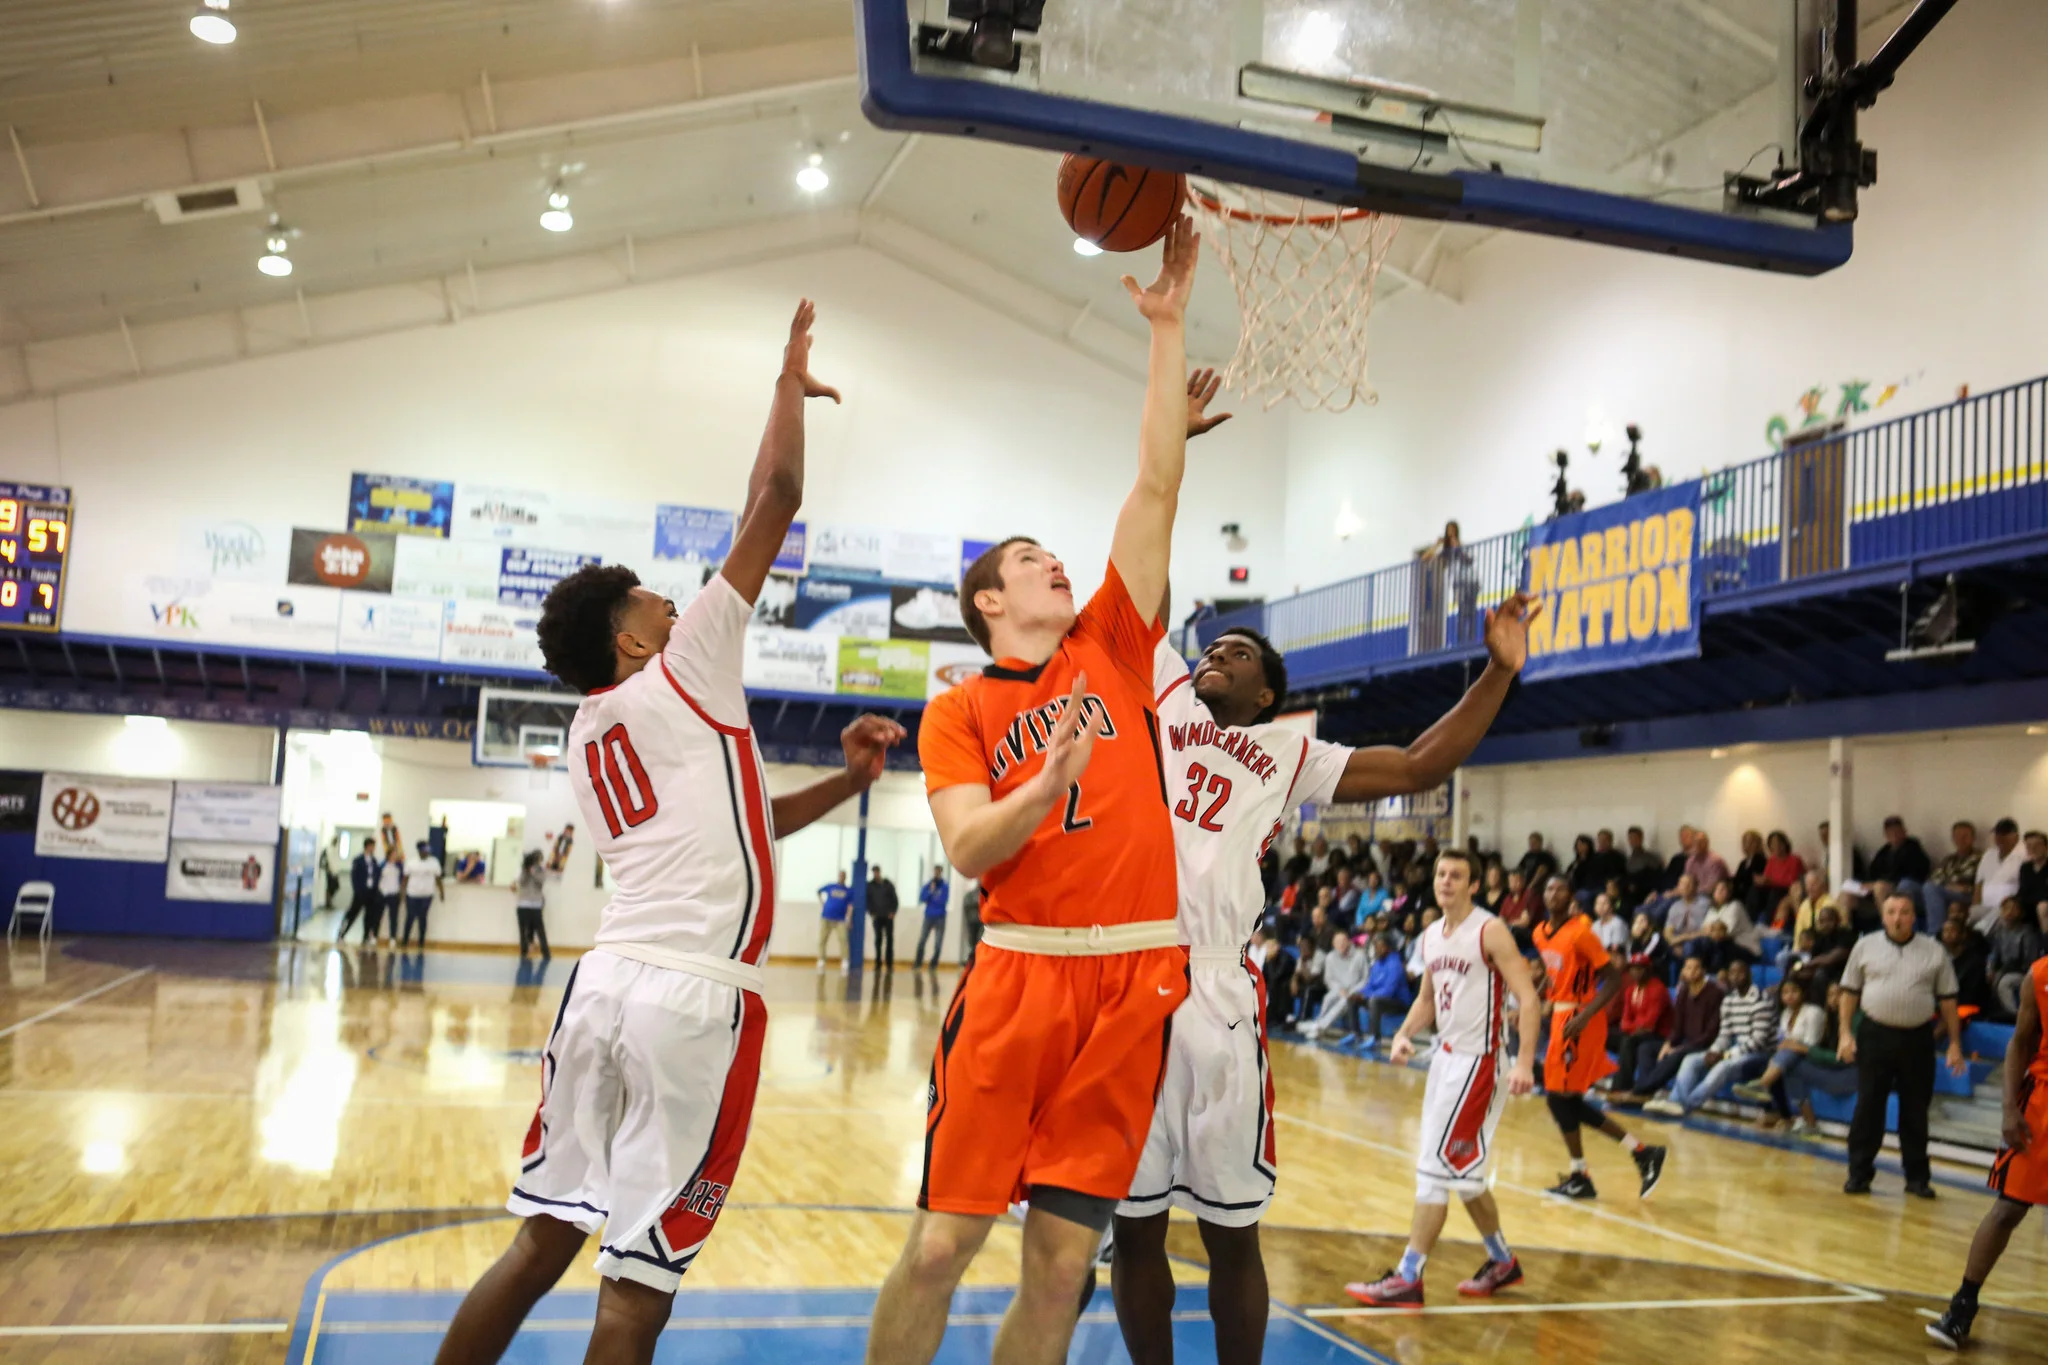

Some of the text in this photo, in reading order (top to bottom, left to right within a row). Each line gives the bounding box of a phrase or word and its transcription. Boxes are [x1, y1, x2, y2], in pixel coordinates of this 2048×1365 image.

[0, 538, 17, 564] 4
[28, 518, 67, 553] 57
[1529, 507, 1694, 592] WARRIOR
[321, 544, 365, 564] John
[0, 580, 18, 607] 0
[38, 583, 54, 610] 7
[150, 602, 199, 629] VPK
[1527, 565, 1691, 658] NATION
[1168, 720, 1277, 786] WNDERMERE
[585, 722, 658, 839] 10
[1174, 761, 1232, 832] 32
